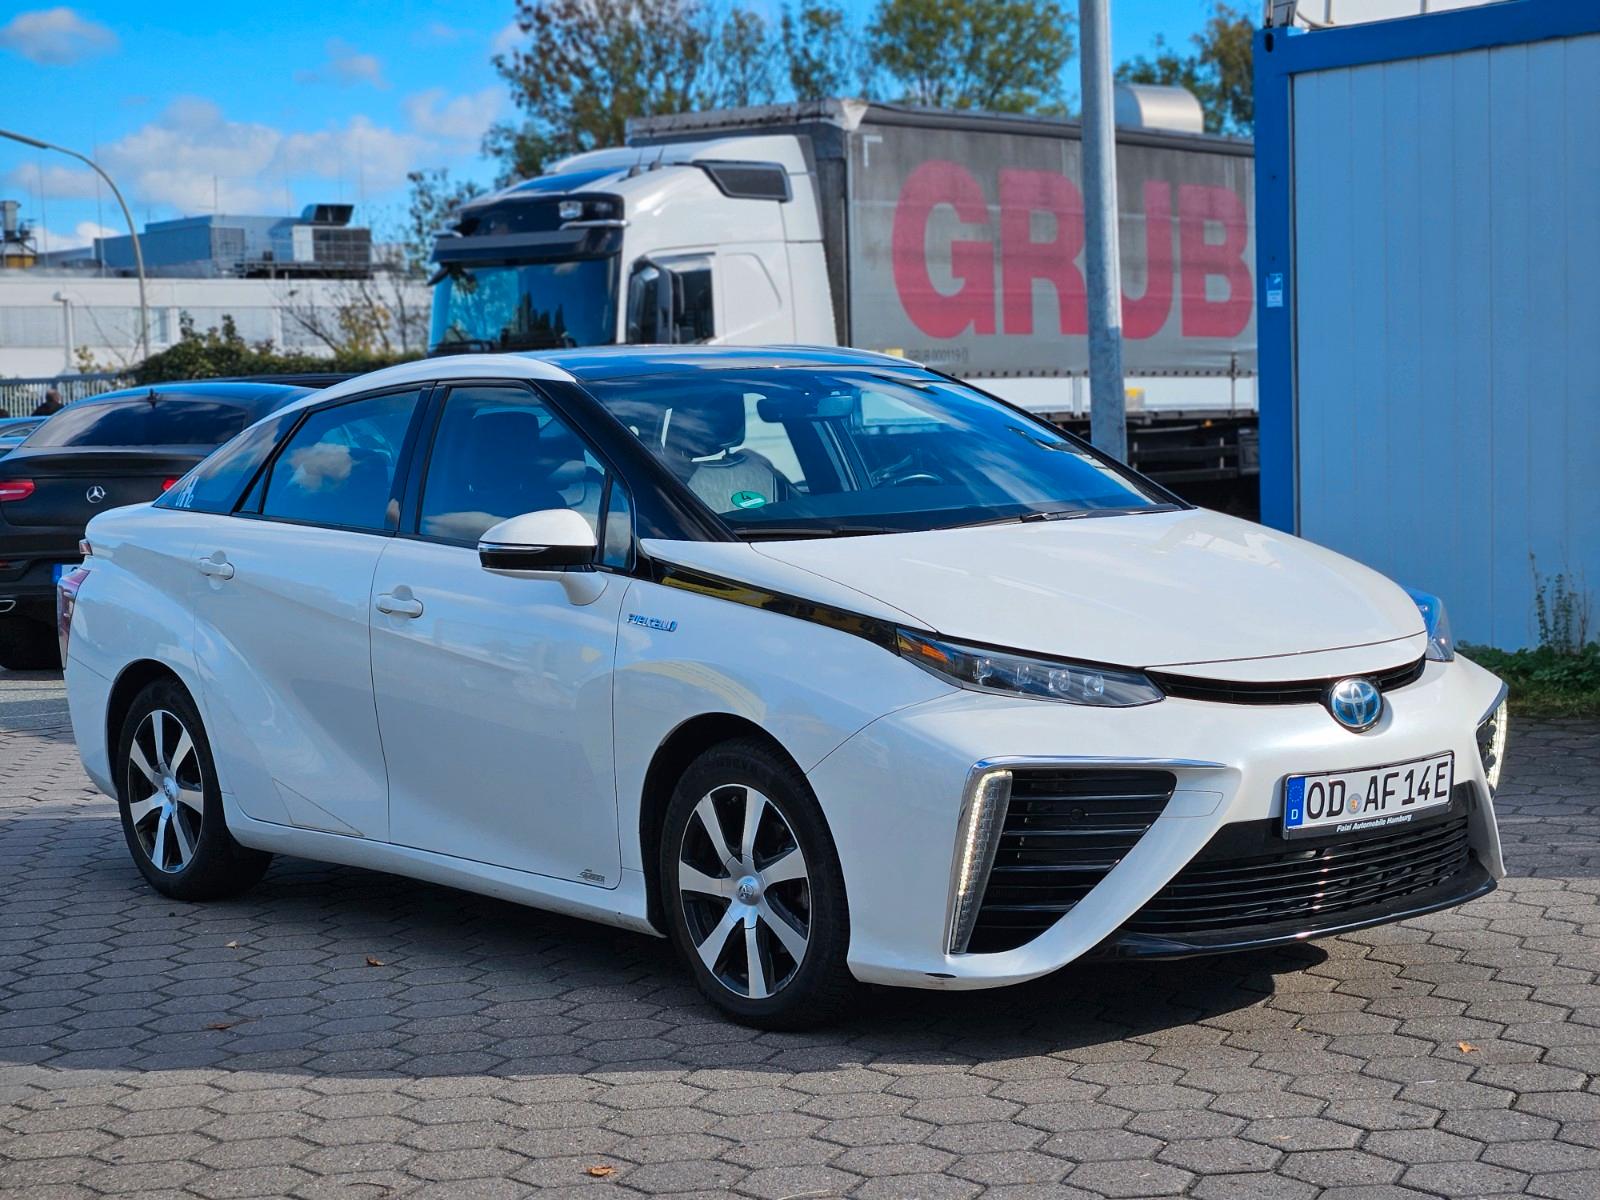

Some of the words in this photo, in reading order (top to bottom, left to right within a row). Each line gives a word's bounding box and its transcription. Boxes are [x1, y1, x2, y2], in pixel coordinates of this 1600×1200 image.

[892, 160, 1253, 339] GRUB
[1306, 780, 1346, 820] OD
[1363, 771, 1399, 811] AF
[1401, 761, 1449, 806] 14E
[1352, 818, 1386, 831] Automobile
